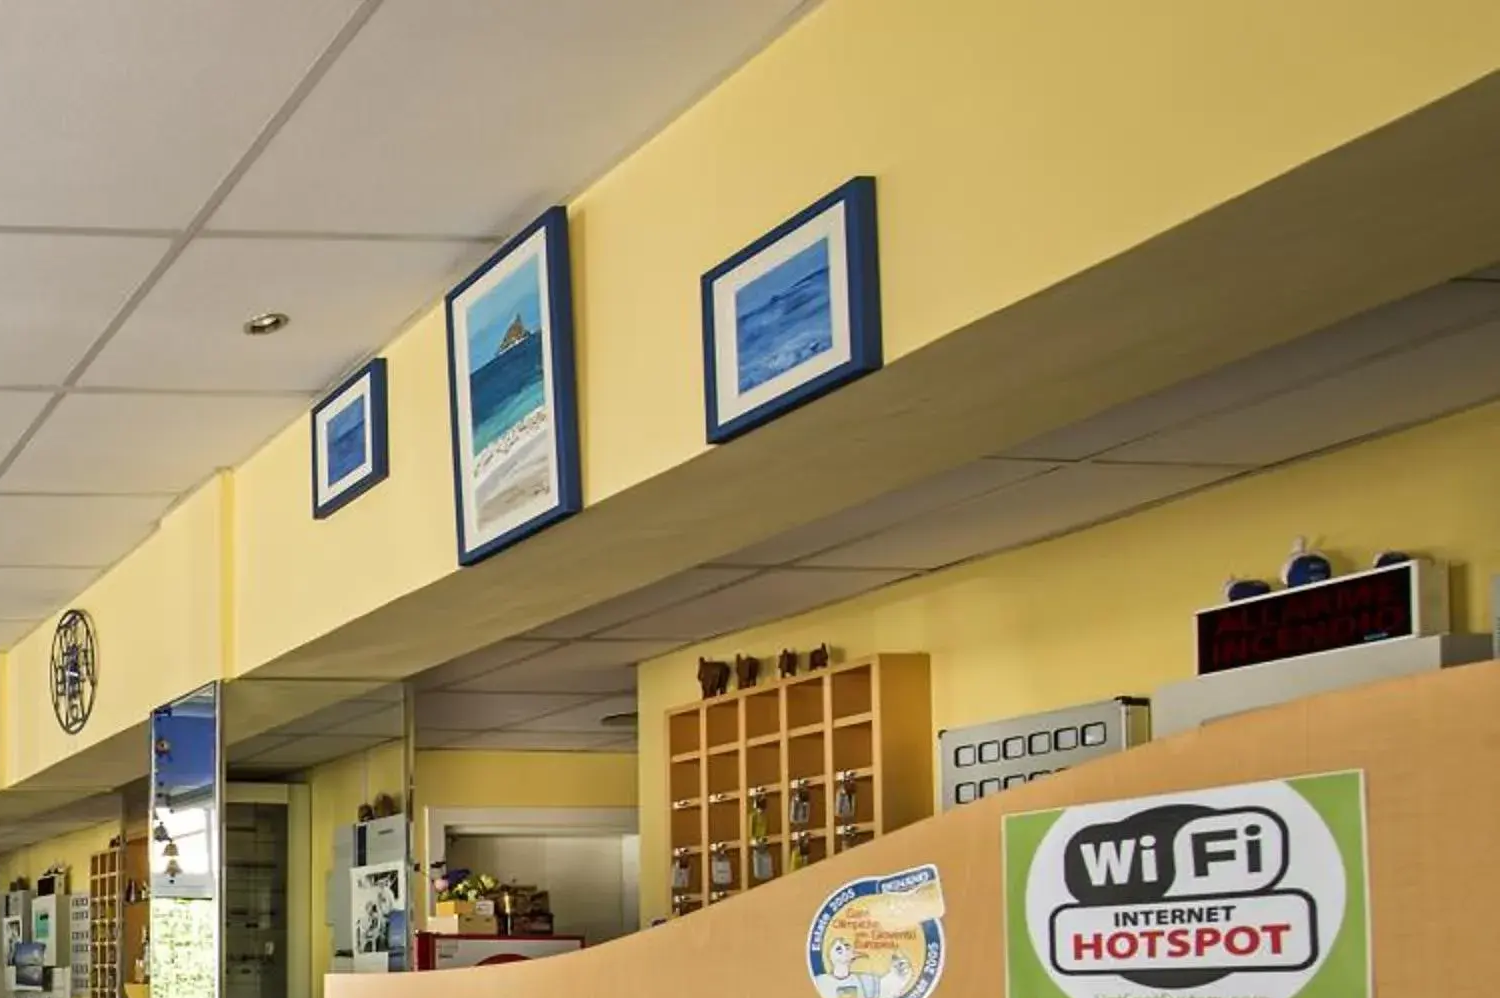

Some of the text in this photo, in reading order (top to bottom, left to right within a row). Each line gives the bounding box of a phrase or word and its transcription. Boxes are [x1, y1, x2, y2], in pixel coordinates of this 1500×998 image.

[1215, 582, 1397, 633] ALLARME
[1212, 608, 1404, 665] INCENDIO
[1113, 905, 1237, 928] INTERNET
[1072, 923, 1292, 961] HOTSPOT
